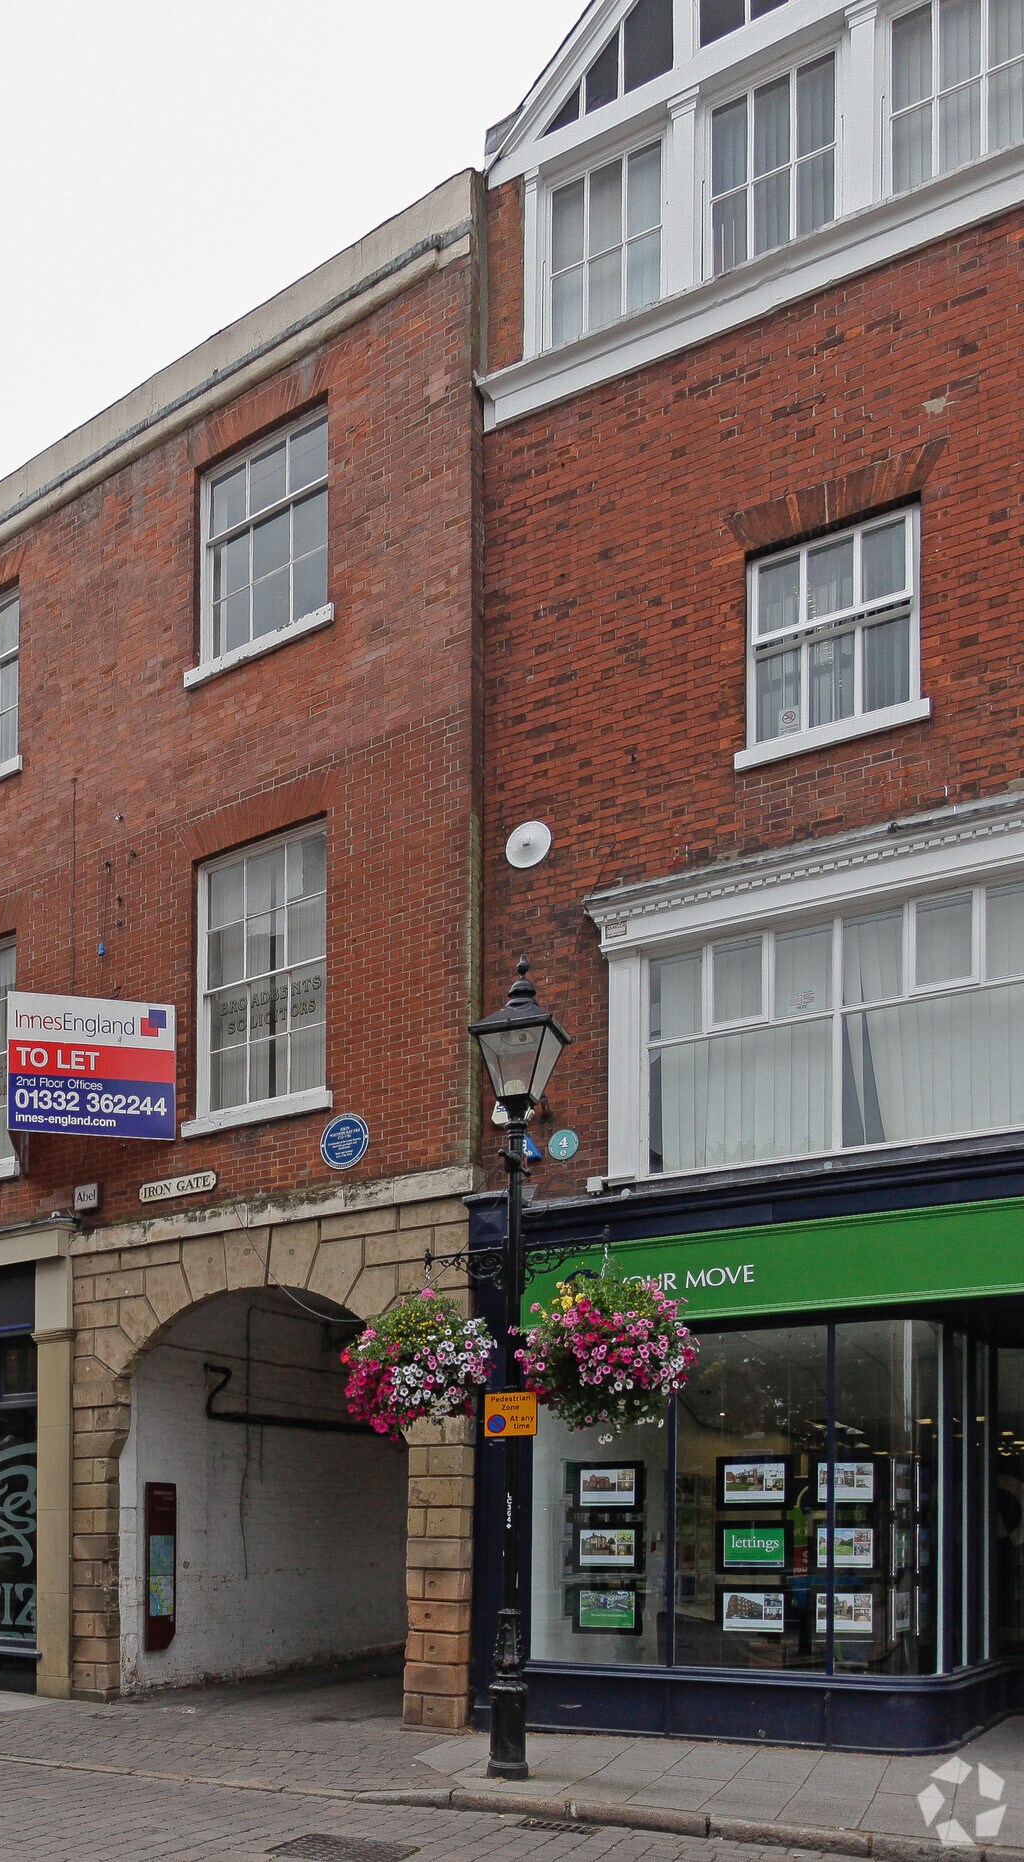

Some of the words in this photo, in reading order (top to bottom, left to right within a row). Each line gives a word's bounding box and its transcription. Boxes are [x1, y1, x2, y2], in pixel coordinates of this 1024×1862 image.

[220, 975, 322, 1017] BROADBENTS
[15, 1009, 135, 1037] InnesEngland
[227, 999, 317, 1036] SOLICITORS
[16, 1046, 49, 1068] TO
[57, 1049, 100, 1071] LET
[16, 1076, 36, 1087] 2nd
[39, 1078, 64, 1089] Floor
[67, 1079, 103, 1091] Offices
[15, 1088, 80, 1111] 01332
[86, 1092, 168, 1116] 362244
[15, 1112, 117, 1128] innes-england.com
[559, 1136, 569, 1148] 4
[76, 1189, 96, 1203] Abel
[143, 1182, 173, 1199] IRON
[176, 1175, 211, 1191] GATE
[685, 1264, 755, 1289] MOVE
[491, 1395, 531, 1403] Pedestrian
[520, 1415, 534, 1423] any
[731, 1535, 780, 1553] lettings
